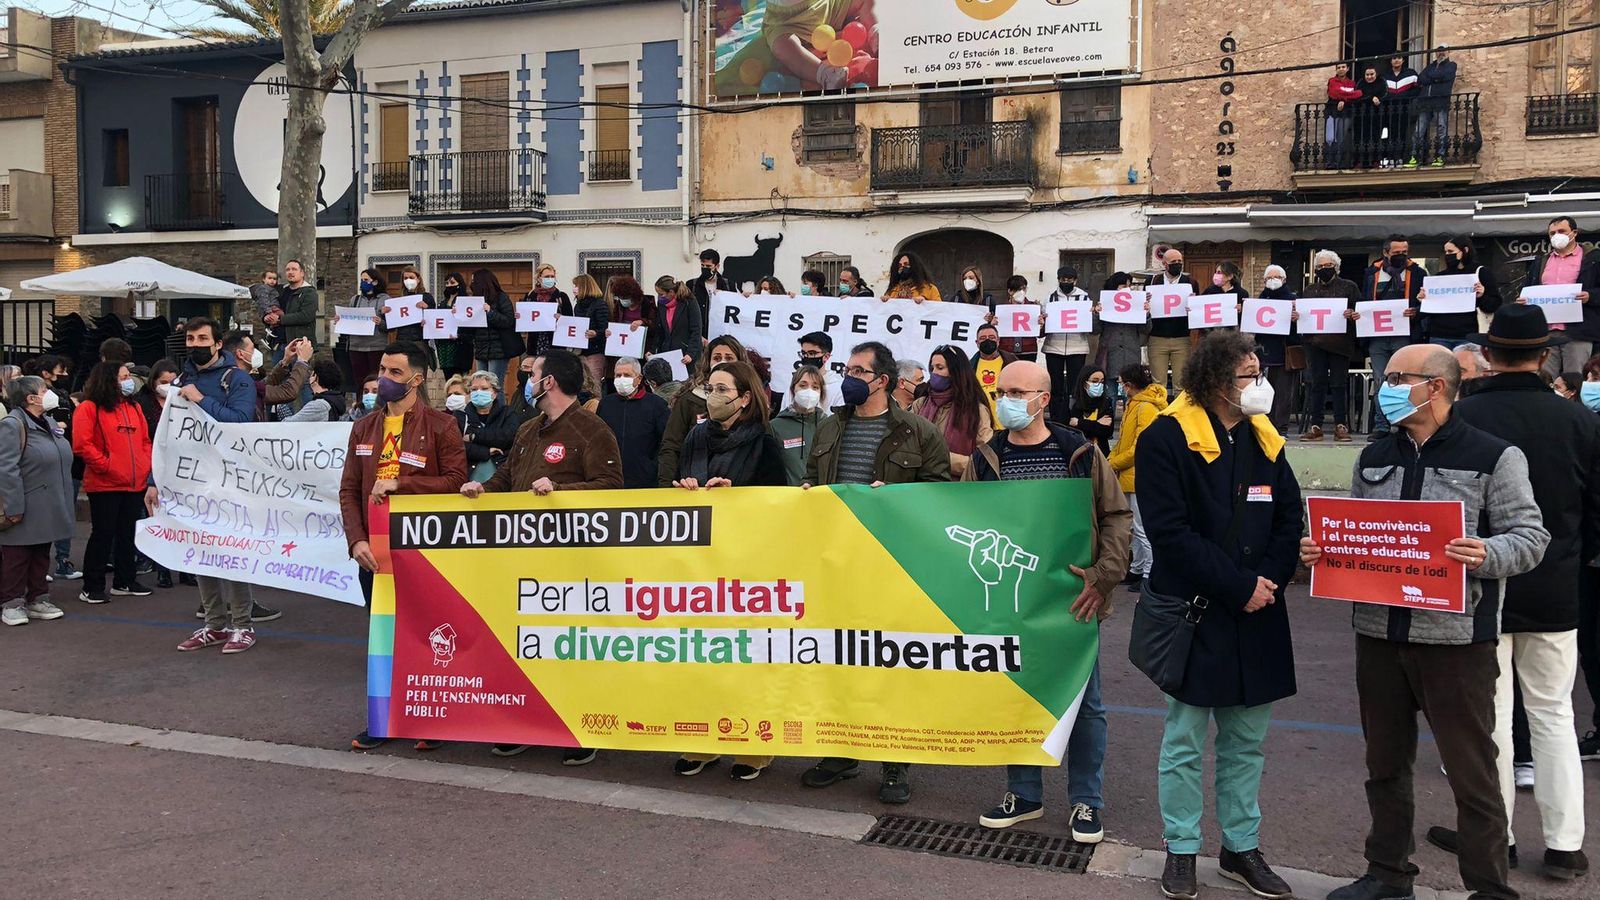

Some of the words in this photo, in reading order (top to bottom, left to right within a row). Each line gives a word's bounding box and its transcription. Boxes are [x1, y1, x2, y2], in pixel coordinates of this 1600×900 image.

[904, 33, 952, 47] CENTRO
[957, 25, 1031, 42] EDUCACIÓN
[1037, 22, 1103, 36] INFANTIL
[949, 51, 959, 60] C/
[963, 49, 1000, 59] Estación
[1023, 45, 1053, 54] Betera
[904, 66, 920, 74] Tel.
[925, 63, 941, 73] 654
[944, 62, 961, 71] 093
[965, 61, 982, 70] 576
[995, 53, 1102, 68] www.escuelaveoveo.com
[267, 76, 289, 95] GAT
[1216, 142, 1235, 155] 23
[1428, 287, 1474, 295] RESPECTE
[400, 306, 409, 317] R
[1113, 292, 1132, 312] S
[1163, 294, 1181, 314] P
[466, 307, 473, 317] S
[531, 311, 540, 321] P
[1060, 310, 1078, 328] E
[1204, 303, 1222, 323] E
[1256, 306, 1277, 327] C
[1310, 309, 1331, 330] T
[1373, 310, 1394, 332] E
[435, 318, 444, 328] E
[568, 326, 576, 337] E
[724, 306, 970, 341] RESPECTE
[1012, 312, 1031, 332] R
[619, 334, 628, 345] T
[176, 456, 206, 483] EL
[402, 515, 442, 545] NO
[451, 514, 487, 545] AL
[495, 512, 609, 544] DISCURS
[619, 510, 699, 543] D'ODI
[1322, 517, 1341, 528] Per
[1344, 519, 1355, 529] la
[1359, 520, 1431, 532] convivència
[1322, 533, 1326, 541] i
[1329, 533, 1339, 542] el
[1343, 533, 1396, 545] respecte
[1400, 535, 1419, 545] als
[1324, 545, 1369, 555] centres
[1371, 546, 1430, 560] educatius
[265, 561, 353, 591] COMBATIVES
[1326, 558, 1342, 568] No
[1345, 560, 1355, 569] al
[1359, 560, 1402, 573] discurs
[1405, 564, 1420, 575] de
[1423, 565, 1448, 578] l'odi
[517, 578, 573, 612] Per
[585, 578, 610, 612] la
[625, 577, 805, 621] igualtat,
[516, 625, 542, 659] la
[554, 626, 752, 663] diversitat
[768, 628, 772, 663] i
[790, 628, 821, 664] la
[834, 629, 1021, 673] llibertat
[407, 674, 483, 688] PLATAFORMA
[406, 690, 428, 702] PER
[432, 691, 526, 706] L'ENSENYAMENT
[405, 702, 448, 718] PÚBLIC
